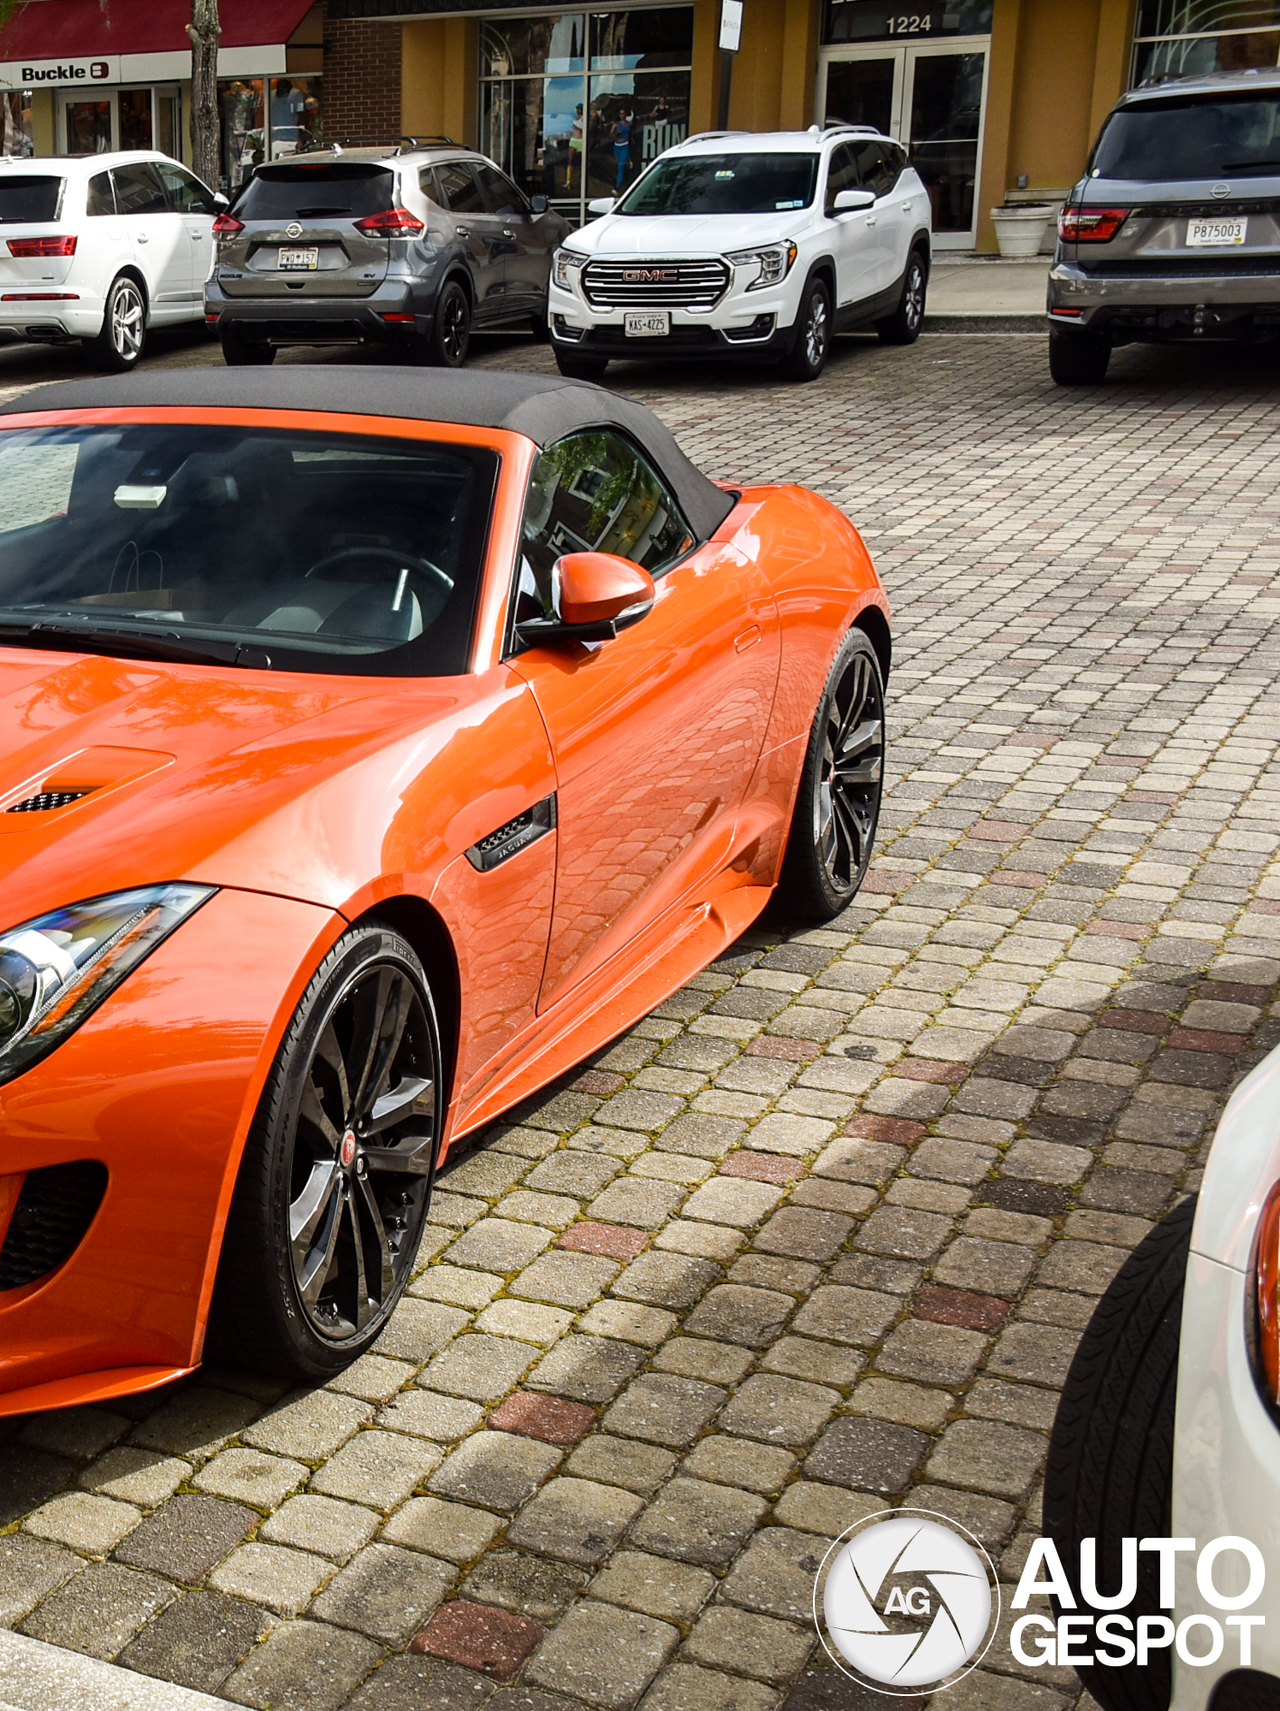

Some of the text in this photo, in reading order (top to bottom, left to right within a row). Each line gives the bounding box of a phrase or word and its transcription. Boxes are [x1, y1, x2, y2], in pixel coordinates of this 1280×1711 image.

[886, 15, 931, 34] 1224
[22, 65, 86, 82] Buckle
[642, 124, 687, 158] RUN
[1193, 225, 1241, 238] P875003
[623, 269, 678, 281] GMC
[498, 834, 532, 859] JAGUAR
[320, 959, 345, 999] OUTSIDE
